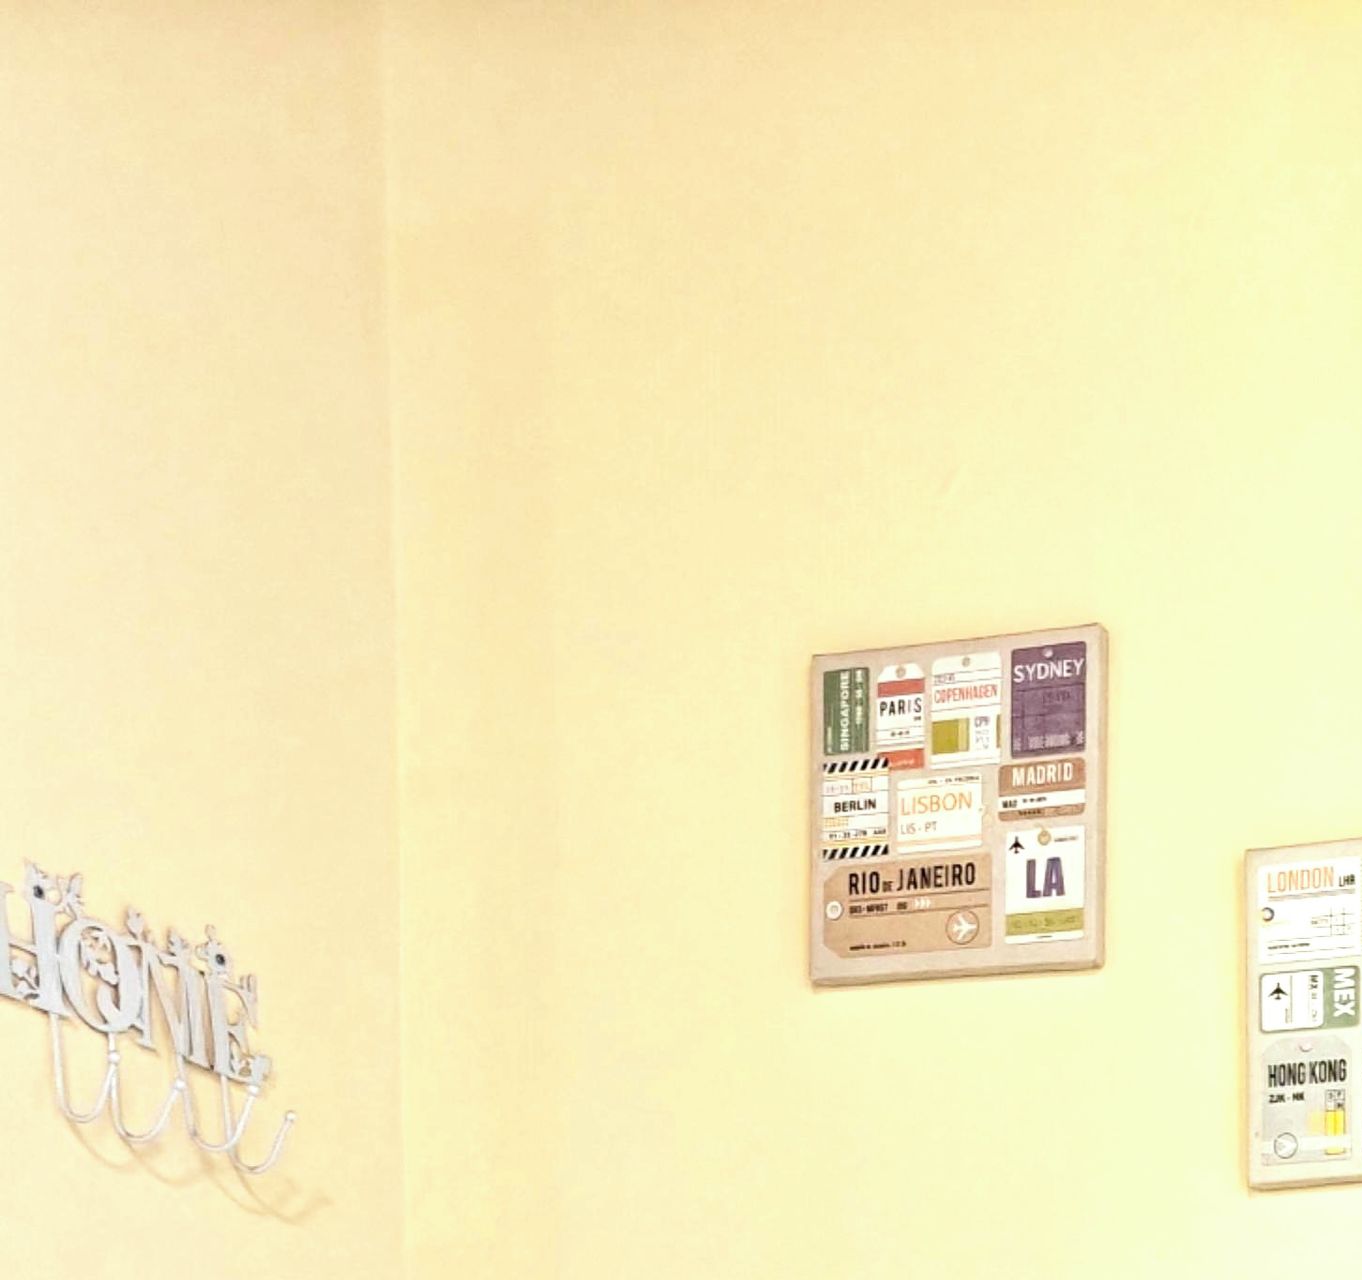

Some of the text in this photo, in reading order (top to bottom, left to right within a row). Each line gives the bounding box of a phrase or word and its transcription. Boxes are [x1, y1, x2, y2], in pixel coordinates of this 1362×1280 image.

[1013, 658, 1084, 683] SYDNEY
[880, 697, 922, 716] PARIS
[934, 684, 998, 704] COPENHAGEN
[839, 670, 850, 751] SINGAPORE
[1012, 762, 1073, 787] MADRID
[834, 798, 876, 813] BERLIN
[901, 791, 972, 816] LISBON
[849, 862, 976, 895] RIO DE JANEIRO
[1026, 857, 1065, 898] LA
[1267, 866, 1334, 893] LONDON
[1333, 968, 1355, 1017] MEX
[1268, 1059, 1347, 1088] HONG KONG
